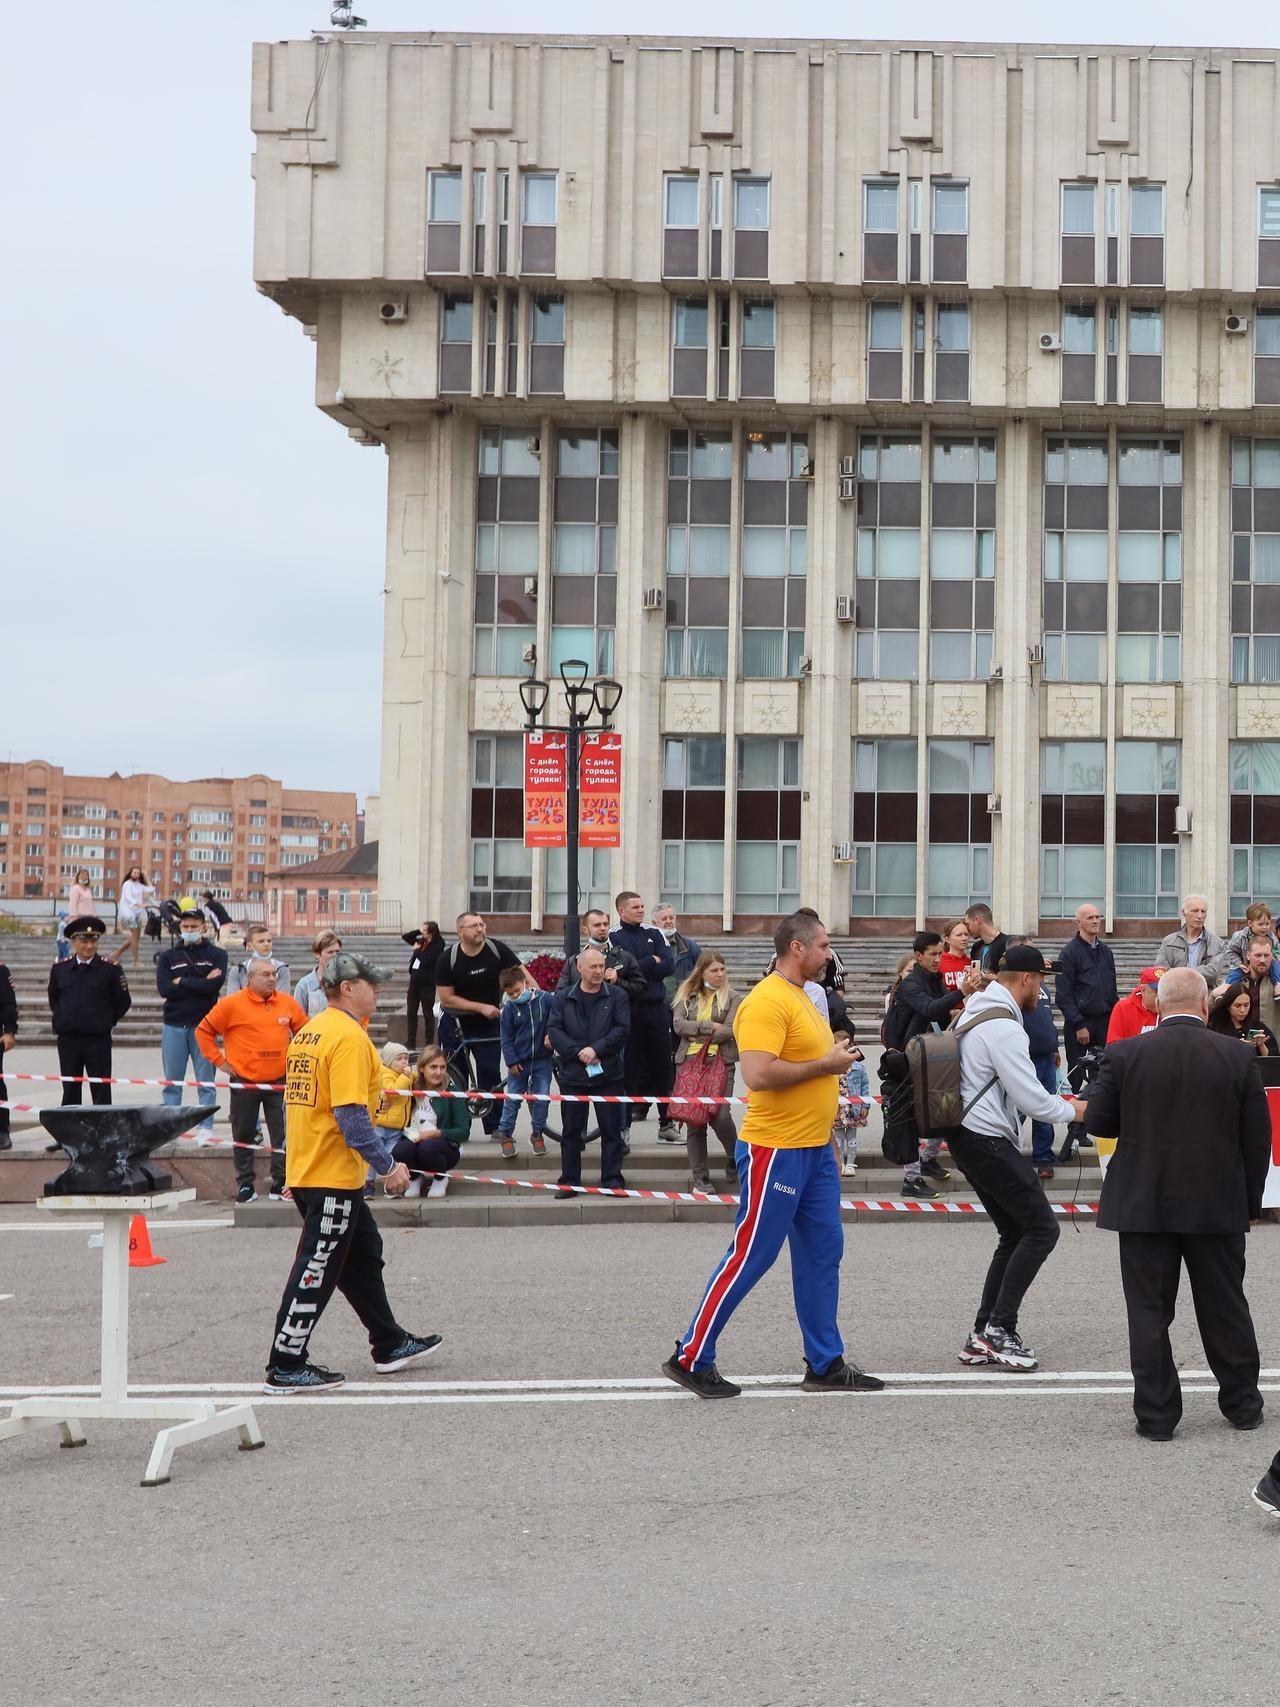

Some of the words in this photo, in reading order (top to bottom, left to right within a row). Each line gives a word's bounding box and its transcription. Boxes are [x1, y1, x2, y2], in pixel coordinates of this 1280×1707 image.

[529, 758, 536, 766] С
[538, 757, 559, 766] днём
[585, 758, 592, 766] С
[593, 758, 615, 767] днём
[529, 767, 562, 776] города,
[529, 776, 562, 785] туляки!
[585, 777, 617, 785] туляки!
[526, 796, 564, 808] ТУЛА
[582, 796, 619, 809] ТУЛА
[773, 1181, 797, 1196] RUSSIA
[274, 1296, 318, 1356] GET
